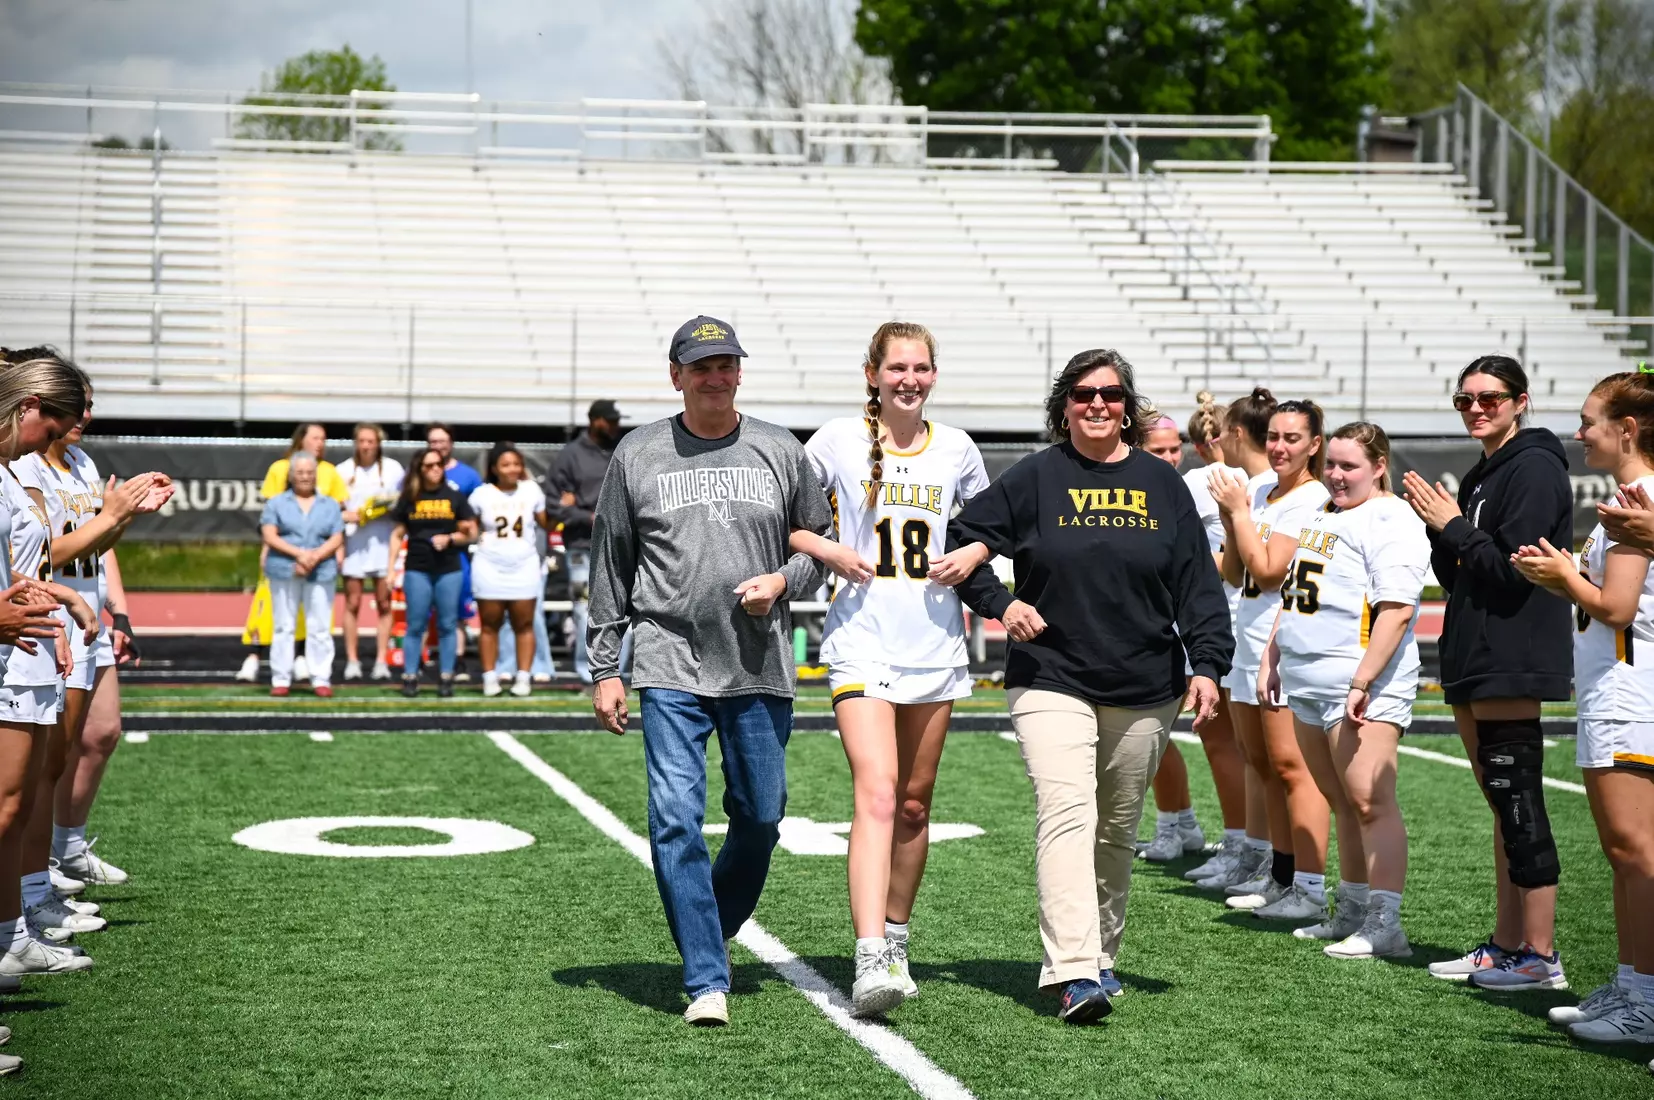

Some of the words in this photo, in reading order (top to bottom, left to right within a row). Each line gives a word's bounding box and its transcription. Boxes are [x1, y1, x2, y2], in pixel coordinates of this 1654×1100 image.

[657, 466, 775, 514] MILLERSVILLE
[1067, 488, 1148, 517] VILLE
[494, 515, 524, 538] 24
[1058, 515, 1159, 530] LACROSSE
[874, 516, 932, 580] 18
